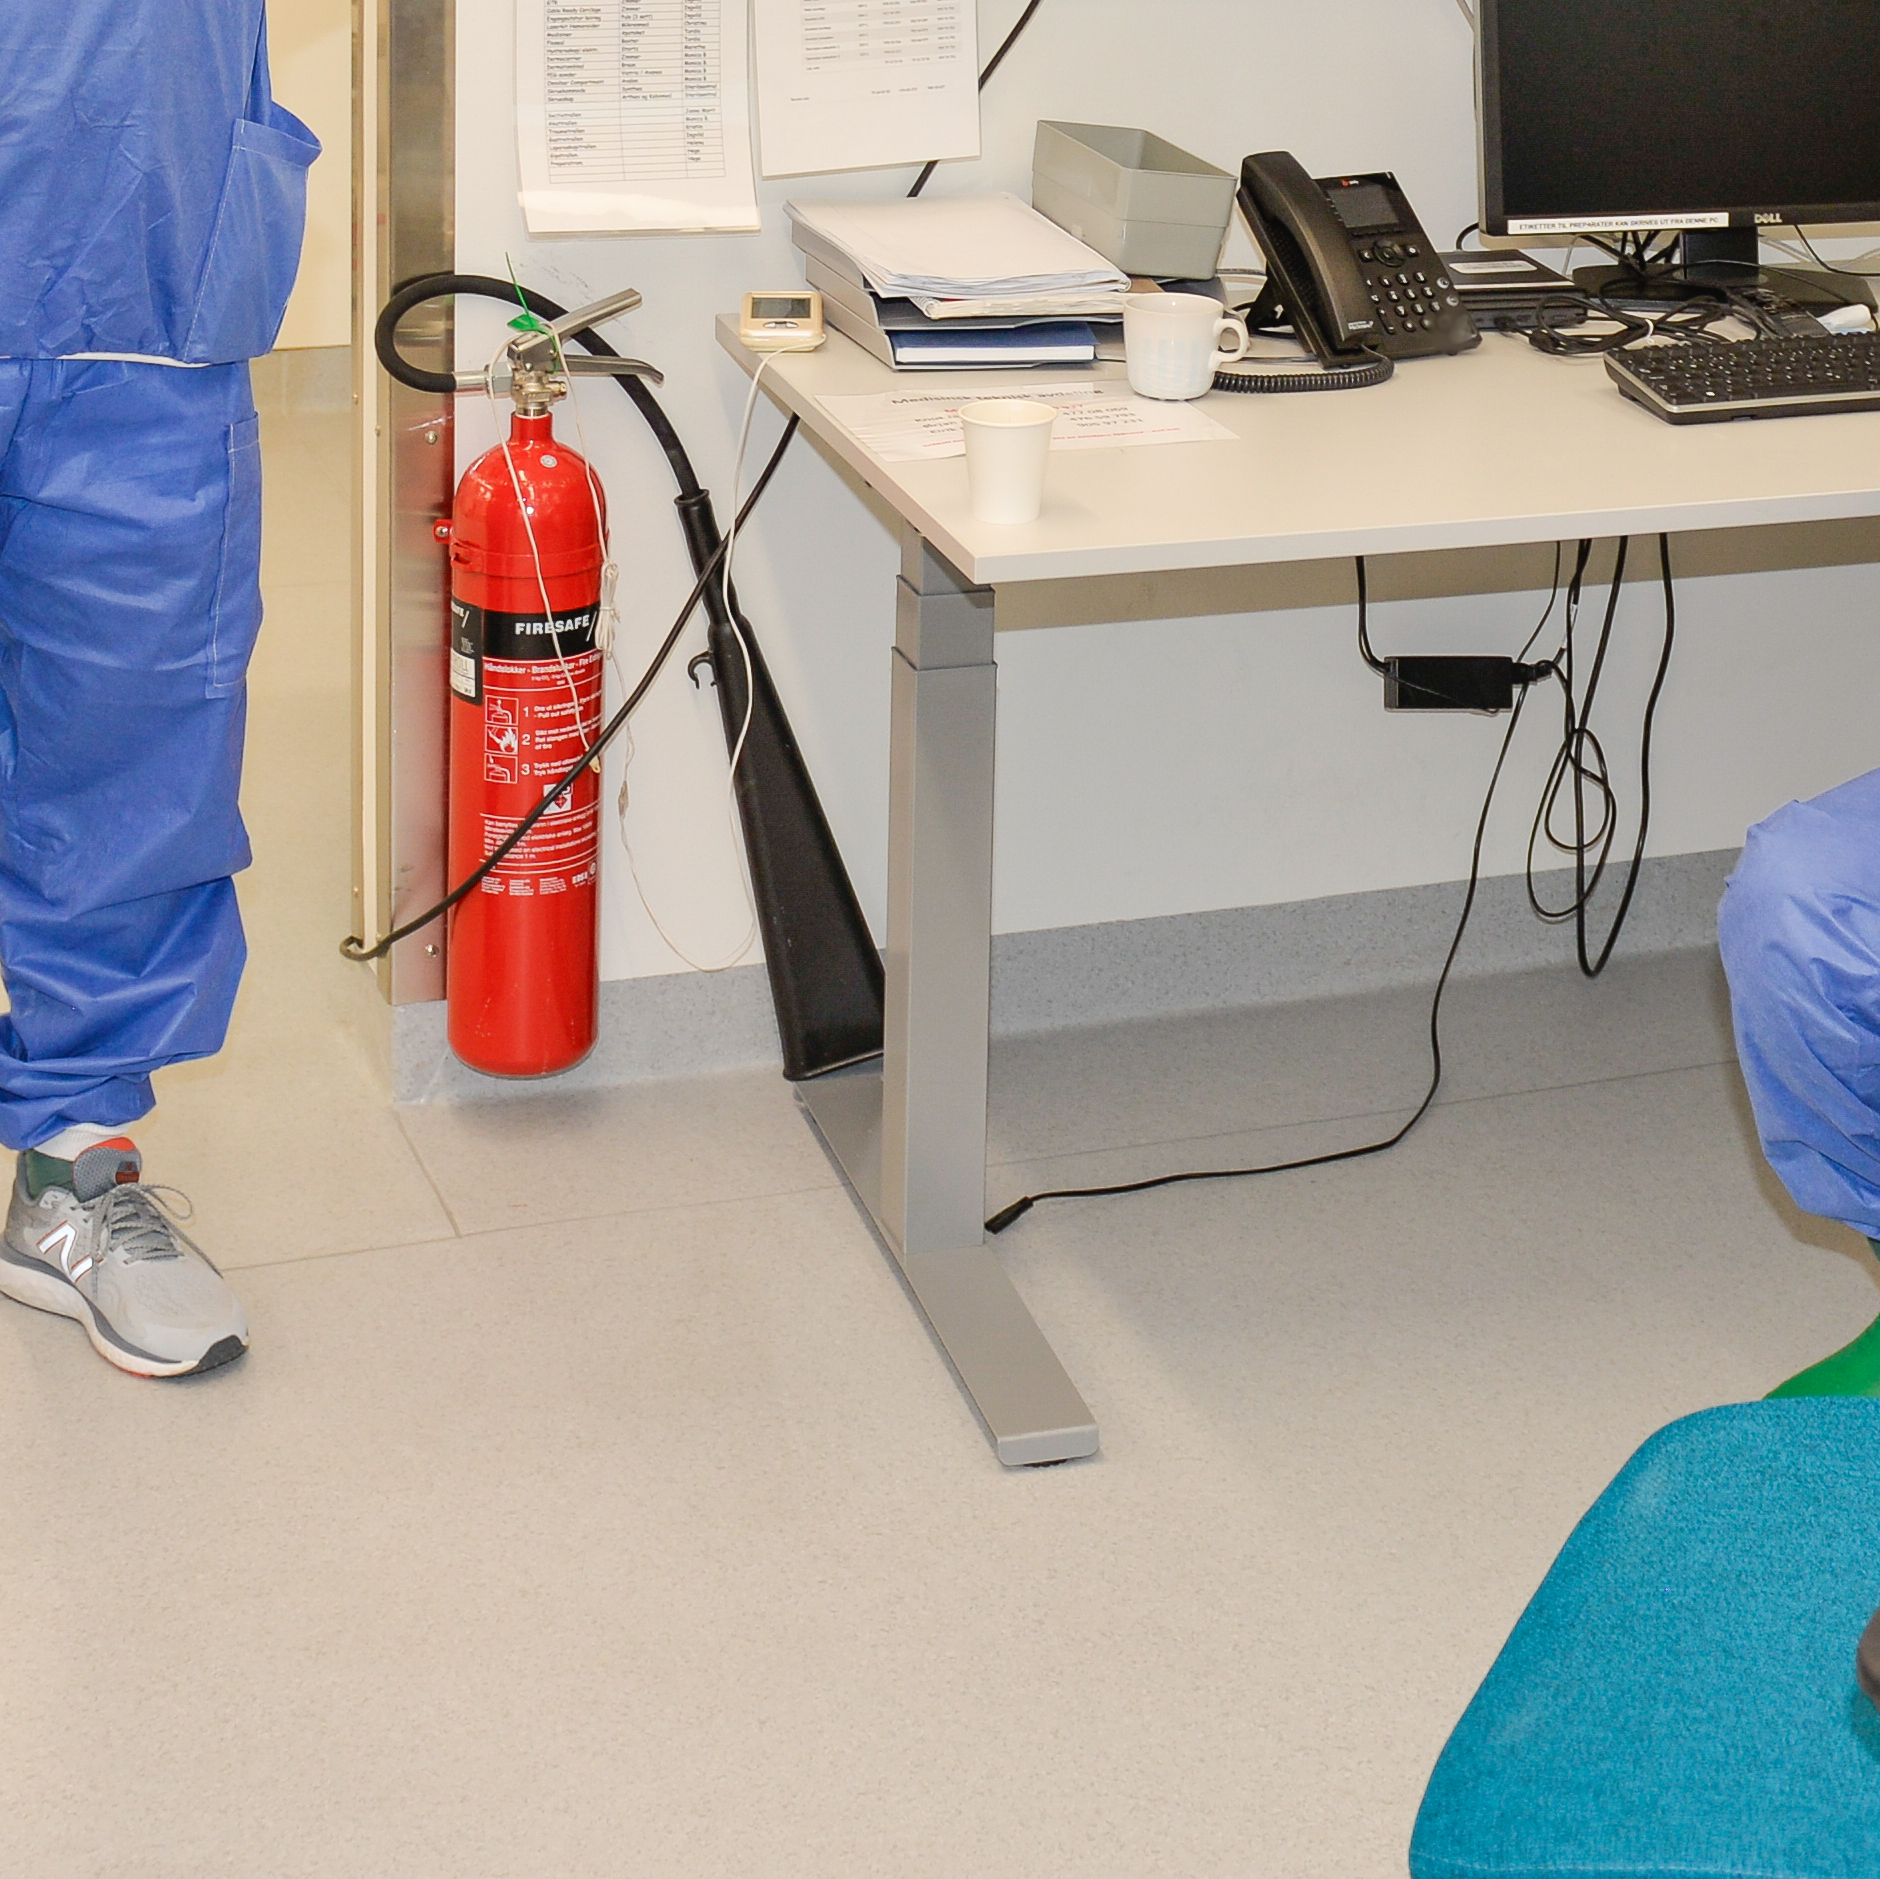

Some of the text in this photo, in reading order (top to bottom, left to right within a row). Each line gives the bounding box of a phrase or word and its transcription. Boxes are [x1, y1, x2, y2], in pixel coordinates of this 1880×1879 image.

[1754, 212, 1783, 223] DELL
[1569, 221, 1614, 229] PREPARATER
[891, 396, 970, 405] Medisinsk
[976, 392, 1031, 400] teknisk
[515, 615, 590, 635] FIRESAFE
[523, 707, 529, 717] 1
[522, 734, 530, 745] 2
[521, 764, 530, 775] 3
